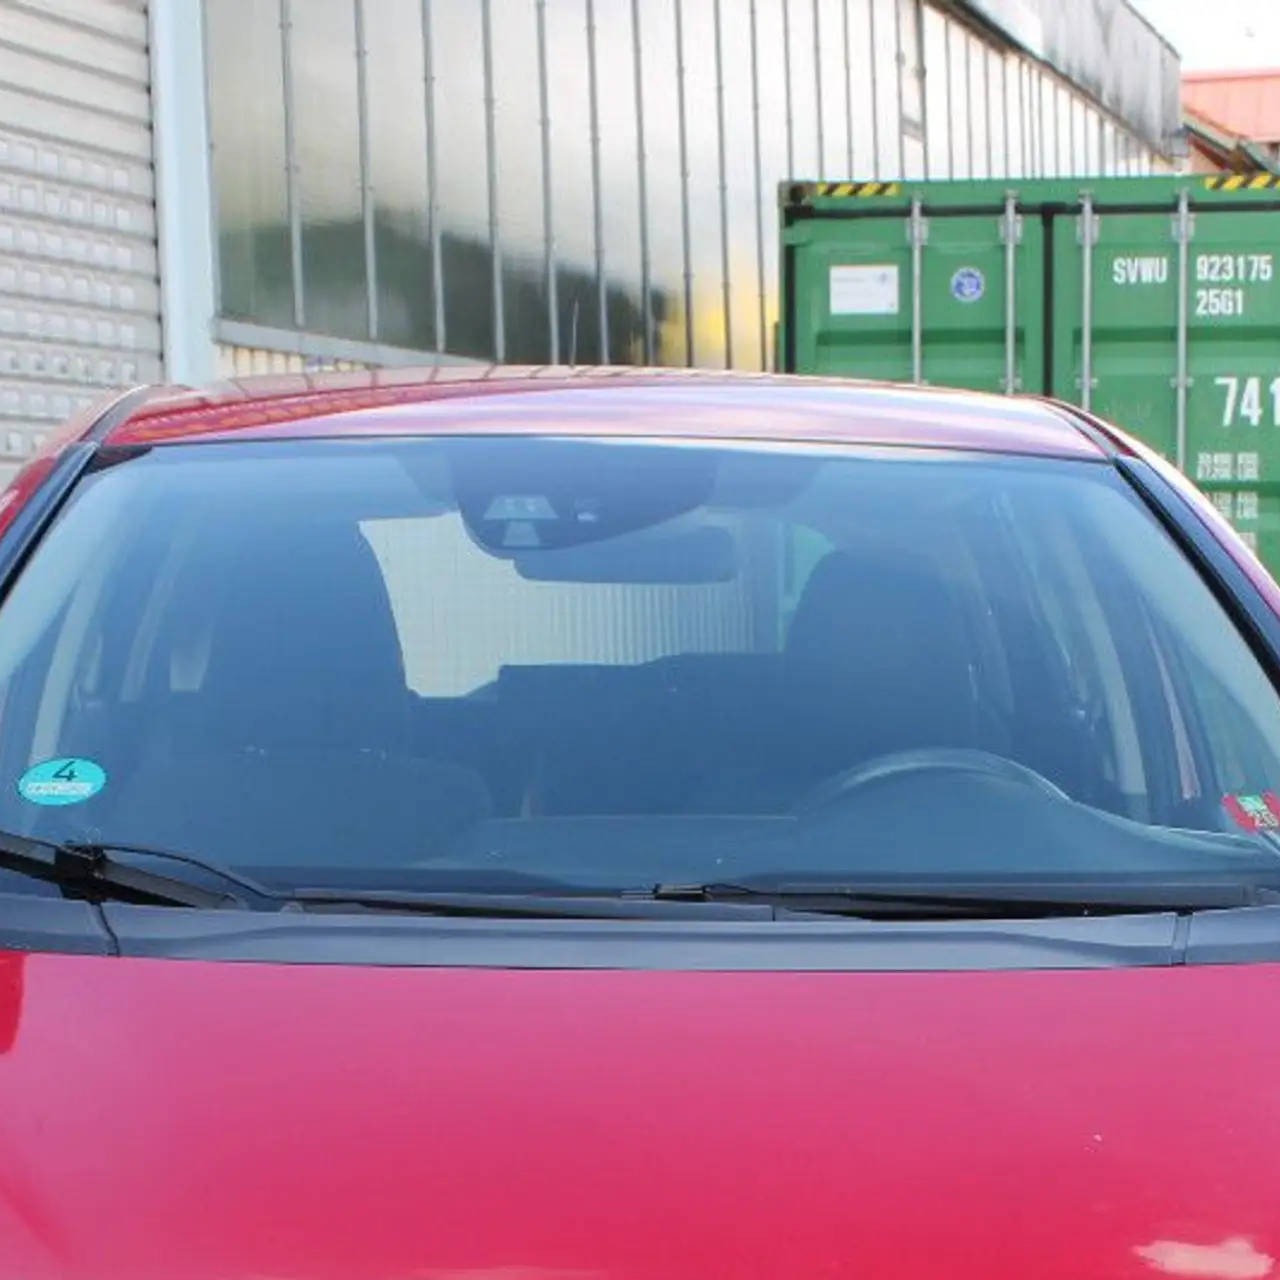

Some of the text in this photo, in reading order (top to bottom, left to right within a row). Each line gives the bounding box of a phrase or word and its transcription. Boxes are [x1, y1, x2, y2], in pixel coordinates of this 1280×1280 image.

[1112, 256, 1168, 284] SVWU
[1195, 254, 1273, 283] 923175
[52, 760, 78, 782] 4
